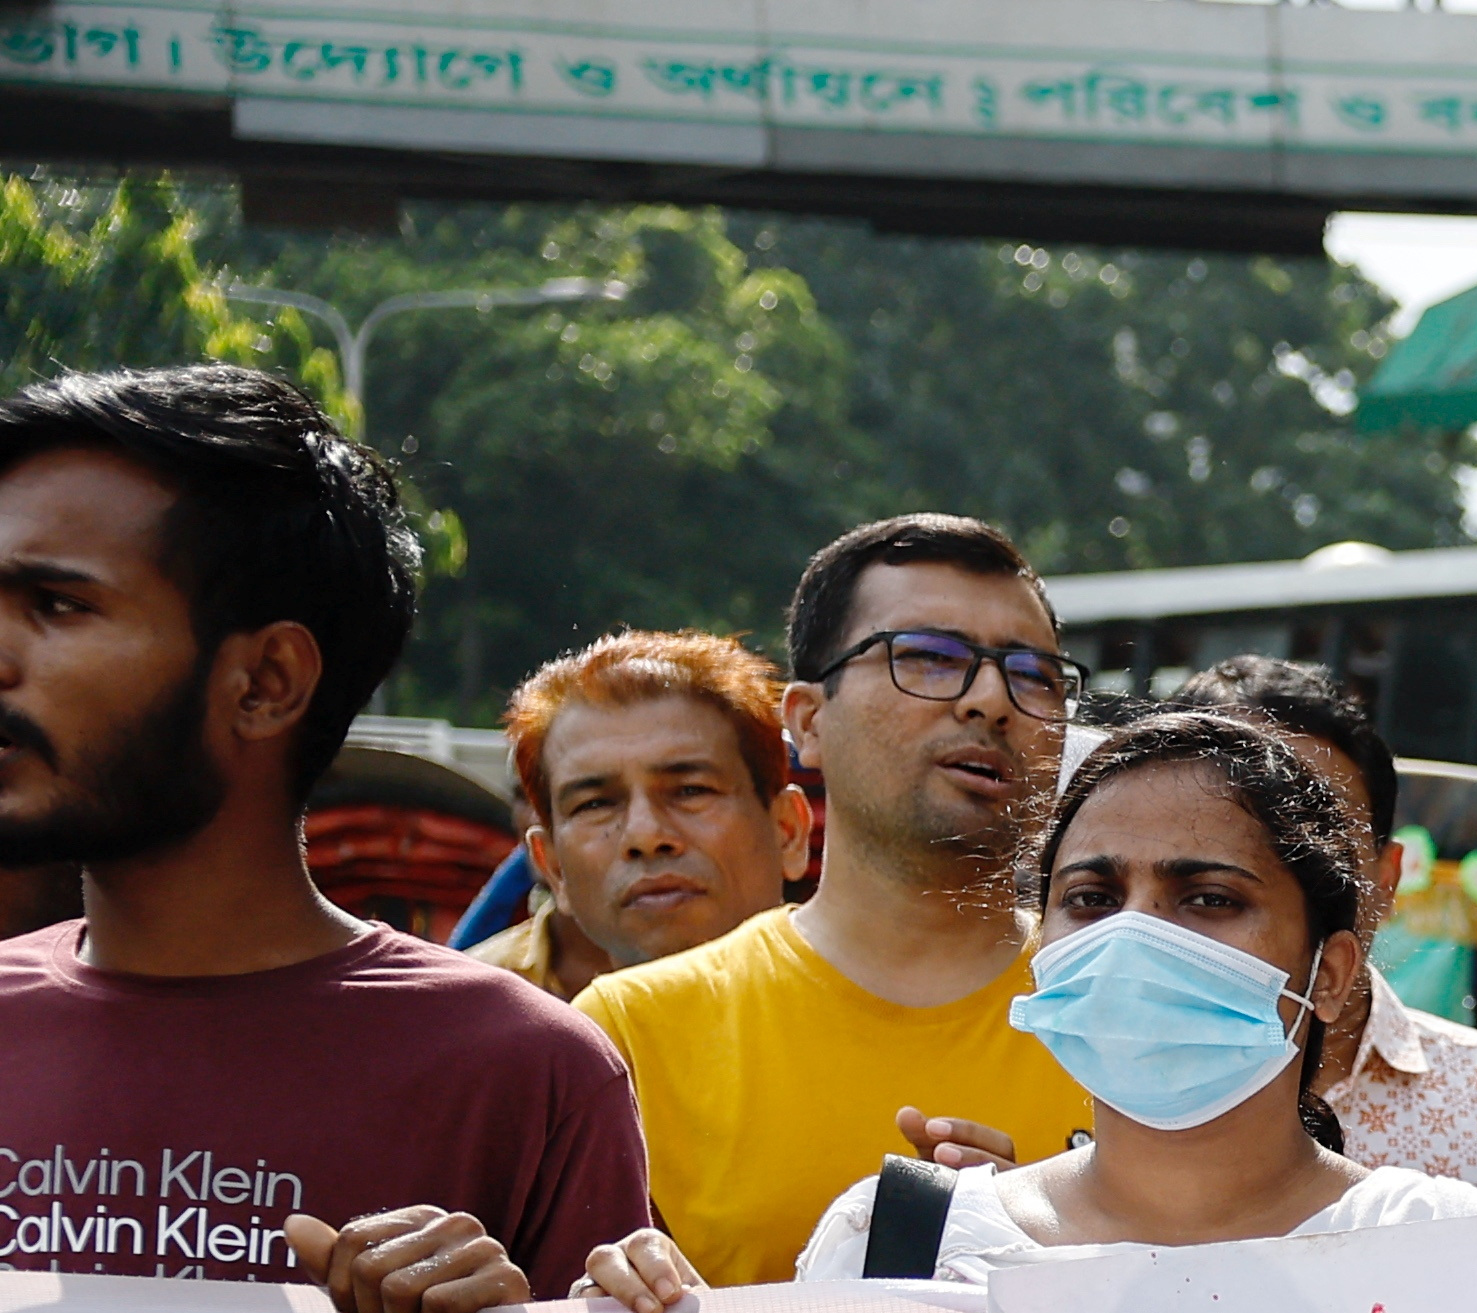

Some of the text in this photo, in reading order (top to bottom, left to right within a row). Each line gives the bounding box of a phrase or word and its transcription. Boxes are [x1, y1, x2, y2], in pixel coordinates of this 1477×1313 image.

[562, 58, 616, 96] ও
[160, 1148, 304, 1211] Klein
[156, 1205, 298, 1268] Klein
